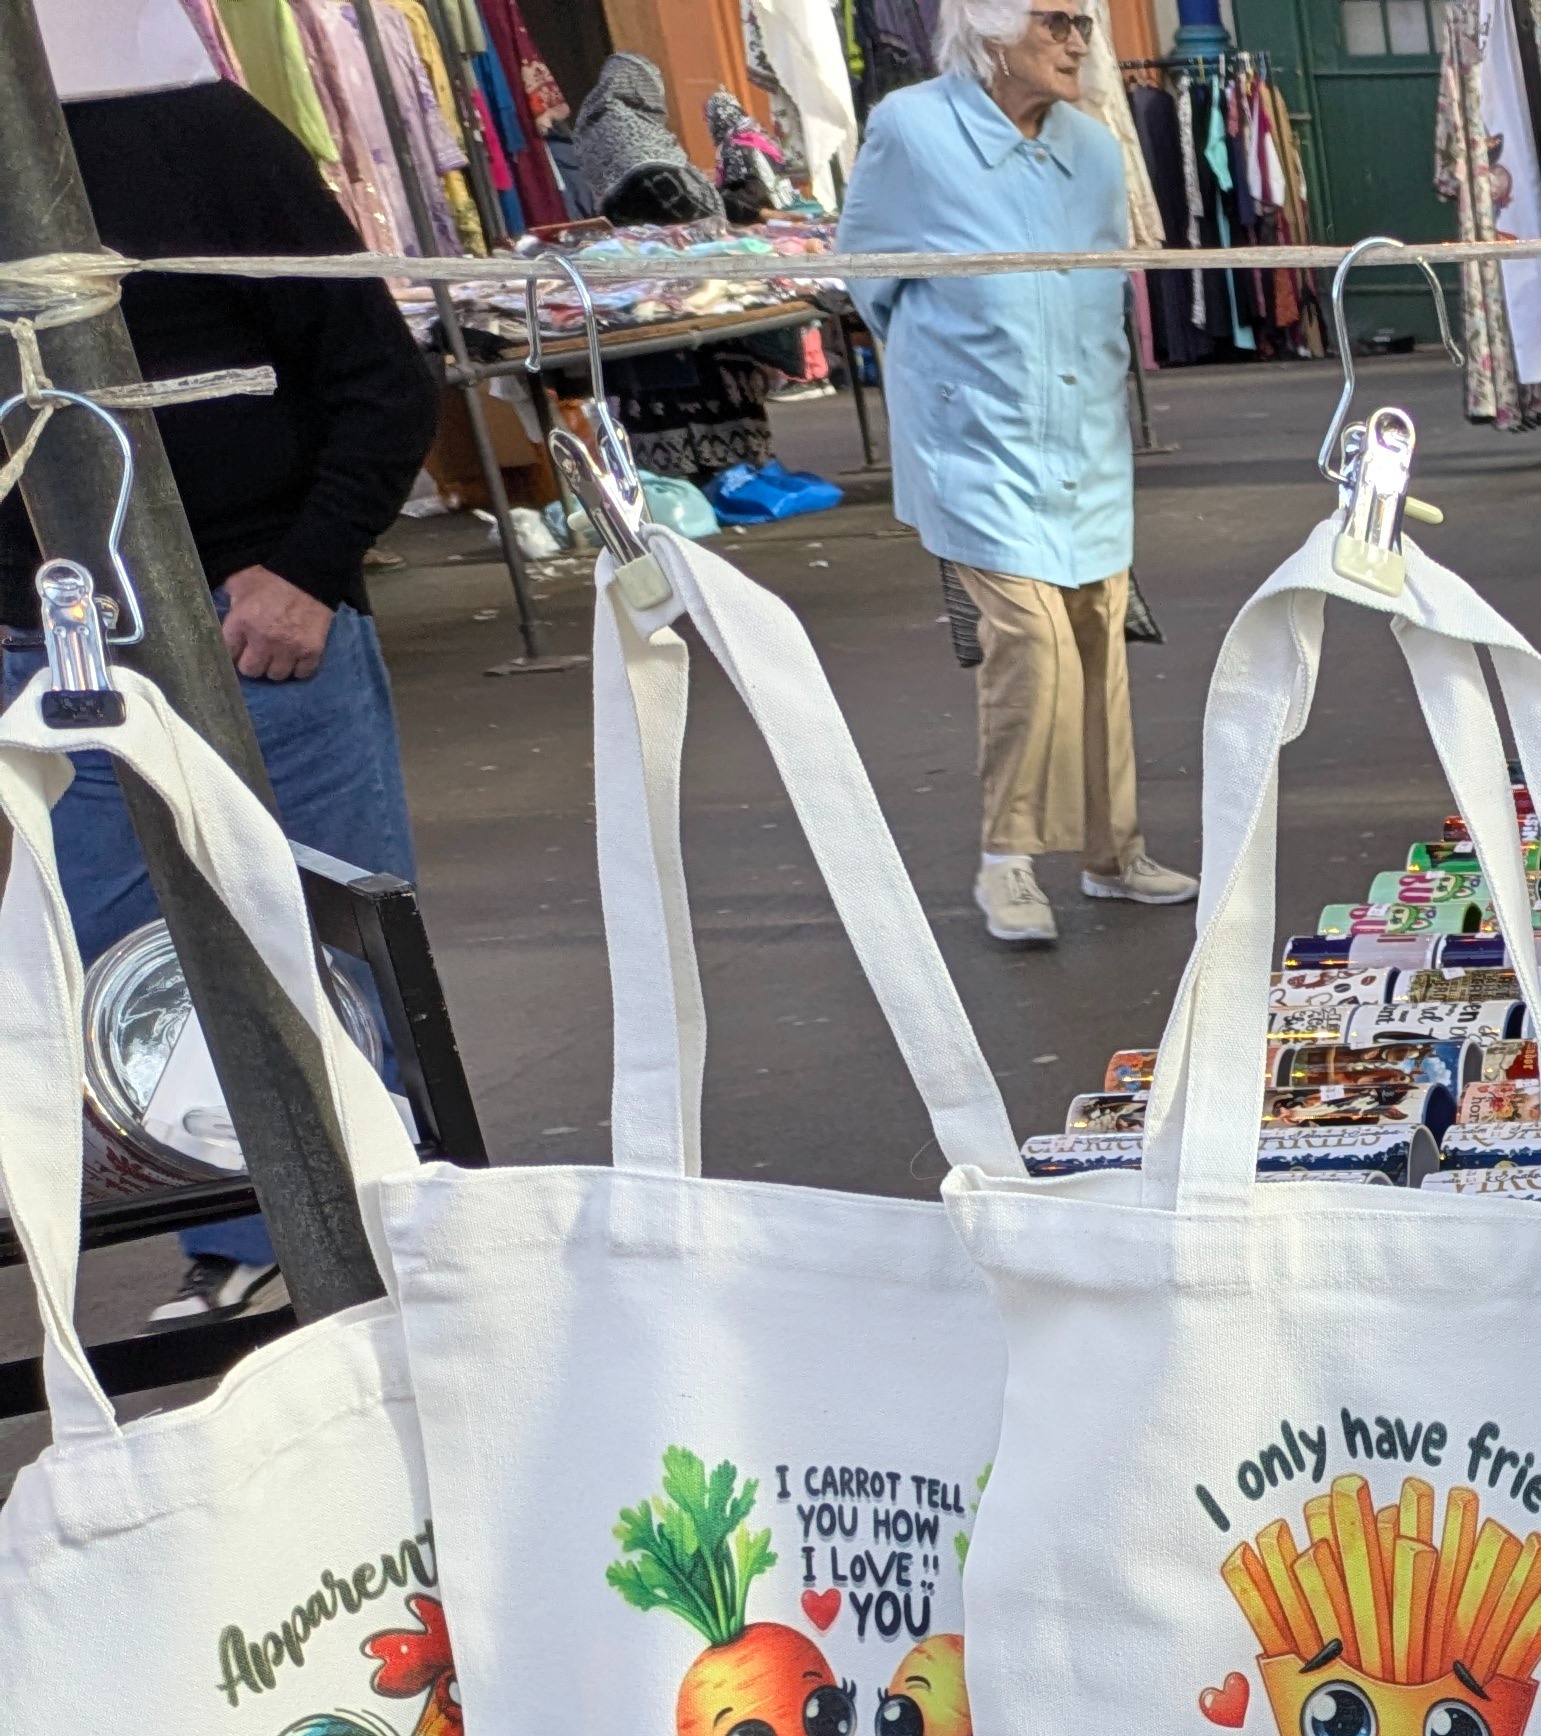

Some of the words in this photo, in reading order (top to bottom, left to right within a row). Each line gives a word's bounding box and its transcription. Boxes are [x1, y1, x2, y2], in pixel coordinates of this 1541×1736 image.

[775, 1464, 791, 1500] I
[804, 1465, 902, 1502] CARROT
[910, 1474, 965, 1514] TELL
[1196, 1483, 1230, 1532] I
[1236, 1419, 1328, 1500] only
[1341, 1407, 1448, 1466] have
[797, 1502, 858, 1540] YOU
[872, 1506, 940, 1546] HOW
[801, 1545, 817, 1583] I
[830, 1545, 913, 1589] LOVE
[215, 1518, 438, 1707] Apparent
[849, 1589, 931, 1637] YOU
